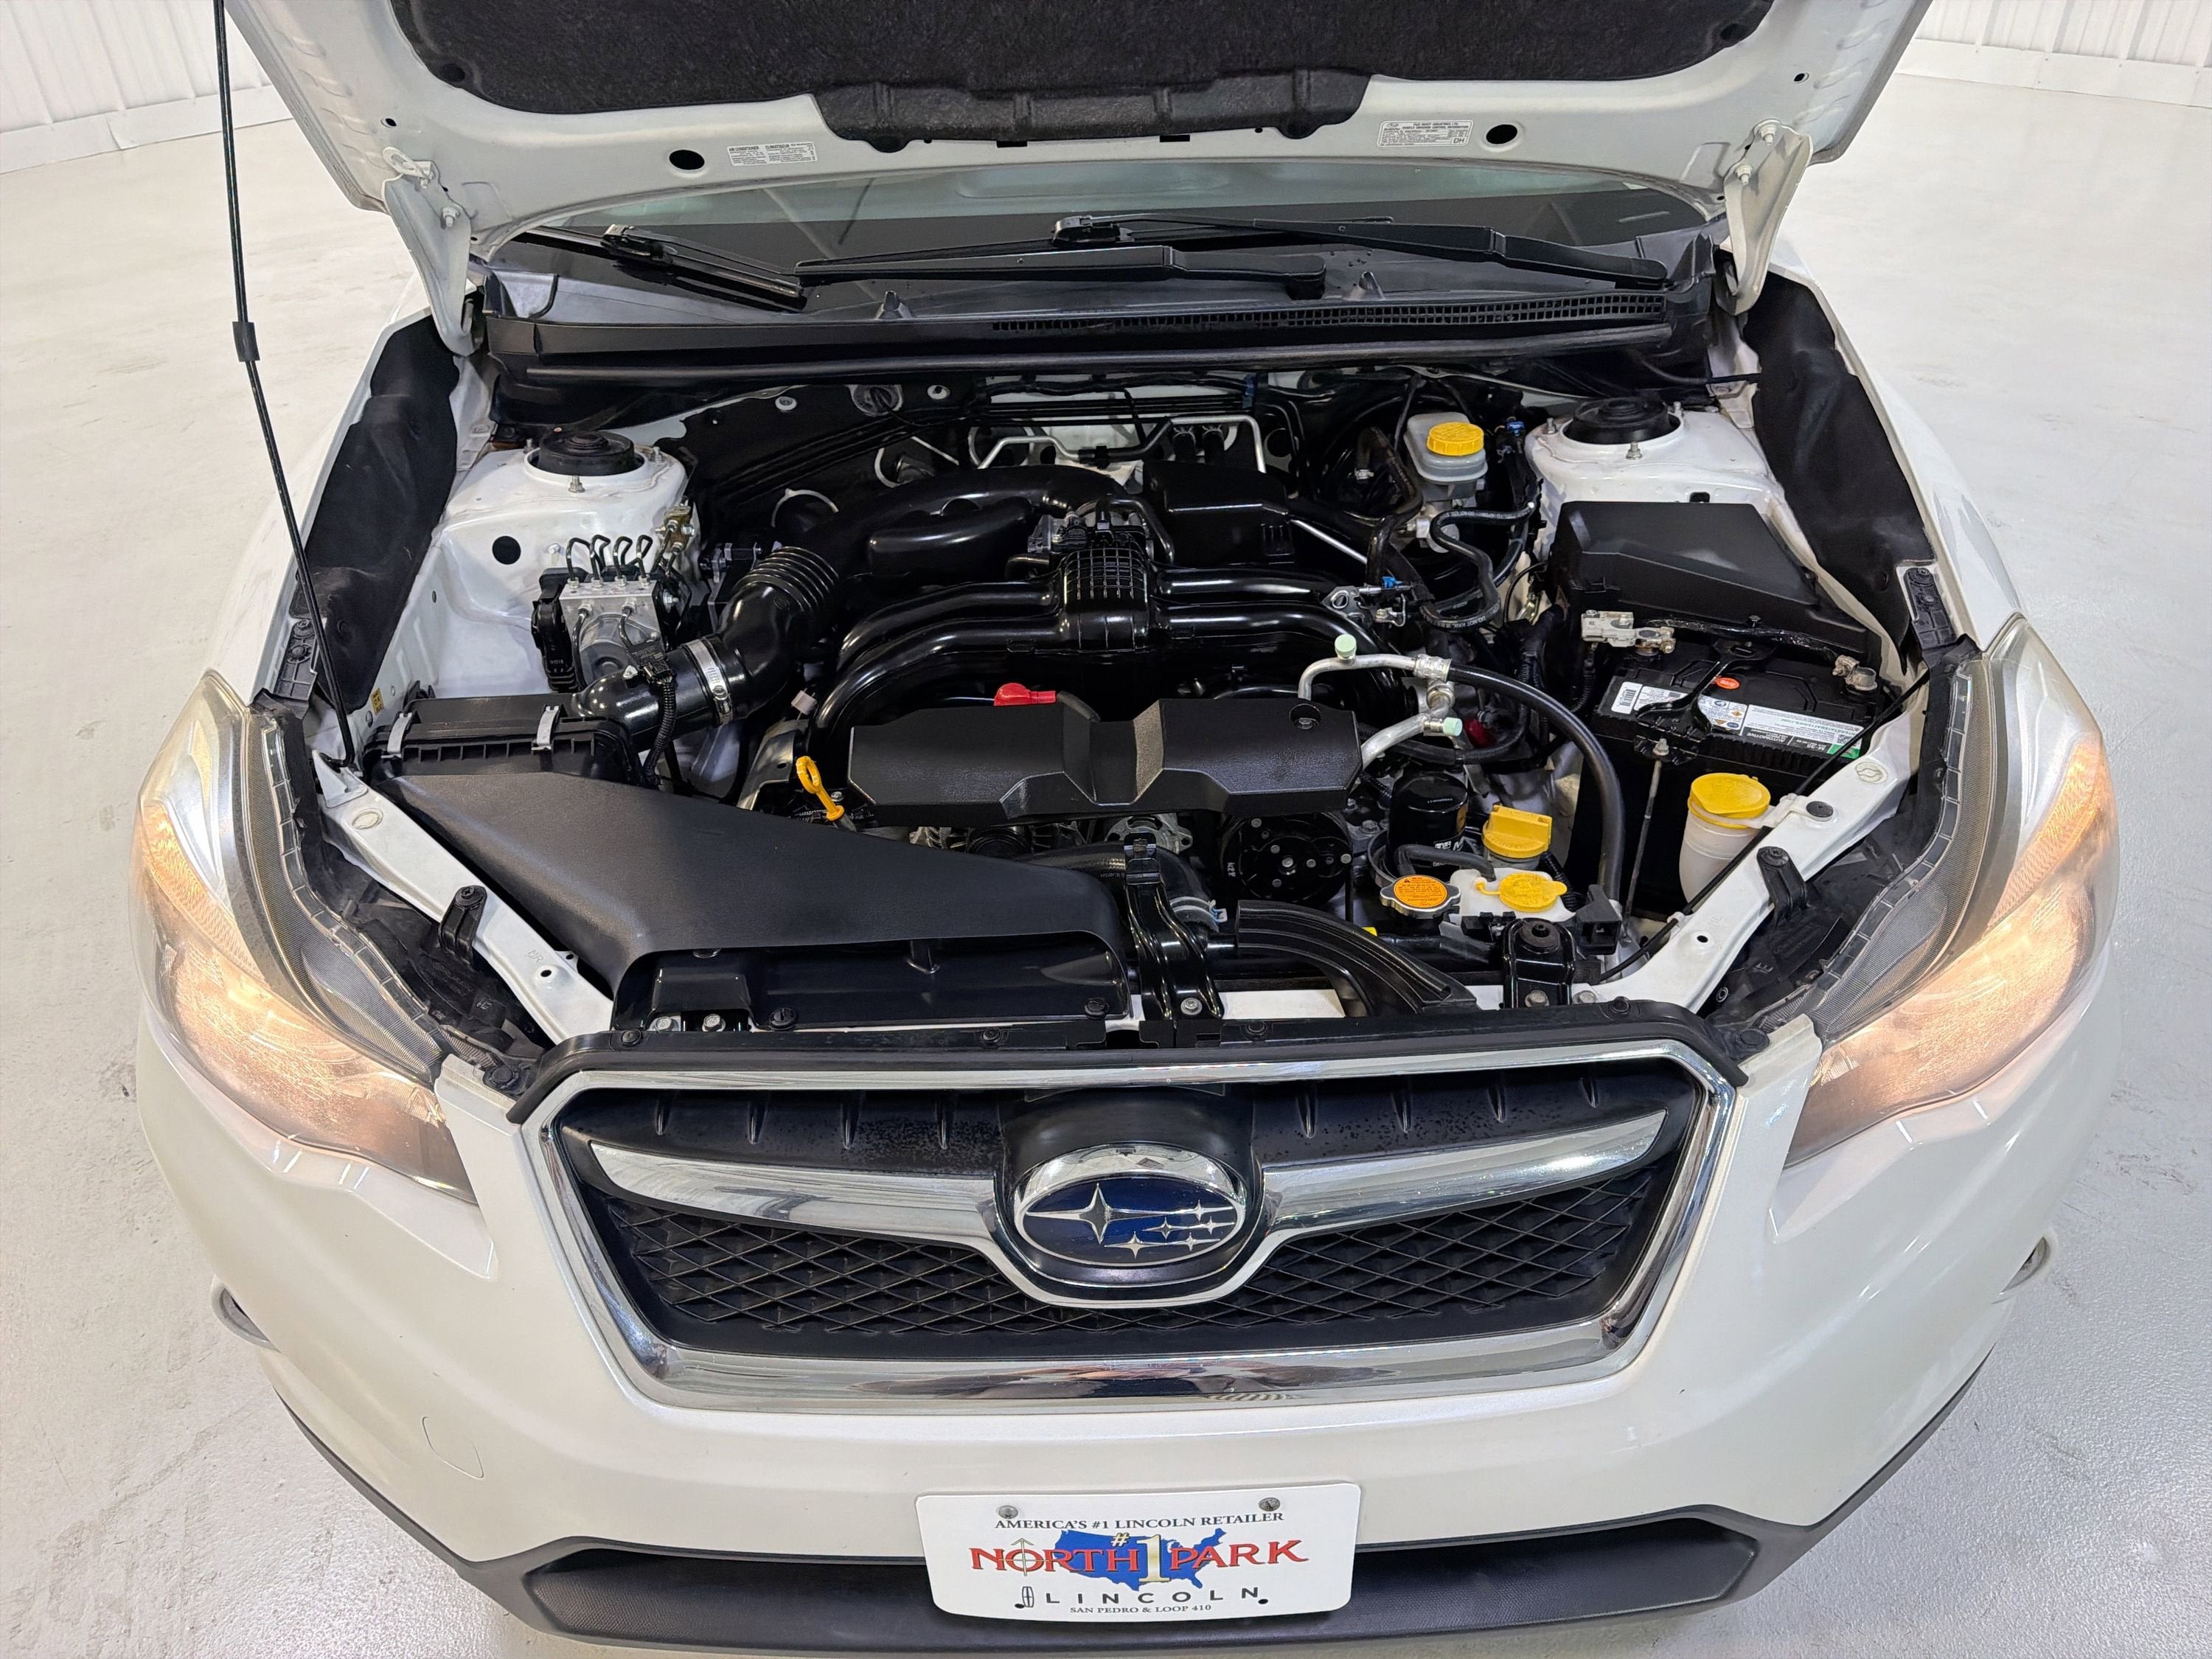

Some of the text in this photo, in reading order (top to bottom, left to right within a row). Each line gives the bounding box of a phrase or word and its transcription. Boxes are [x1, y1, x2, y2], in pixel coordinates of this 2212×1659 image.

[1746, 732, 1787, 743] AUTOMOTIVE
[995, 1512, 1285, 1529] AMERICA'S #1 LINCOLN RETAILER
[969, 1540, 1310, 1573] NORTH PARK
[1046, 1587, 1259, 1604] LINCOLN
